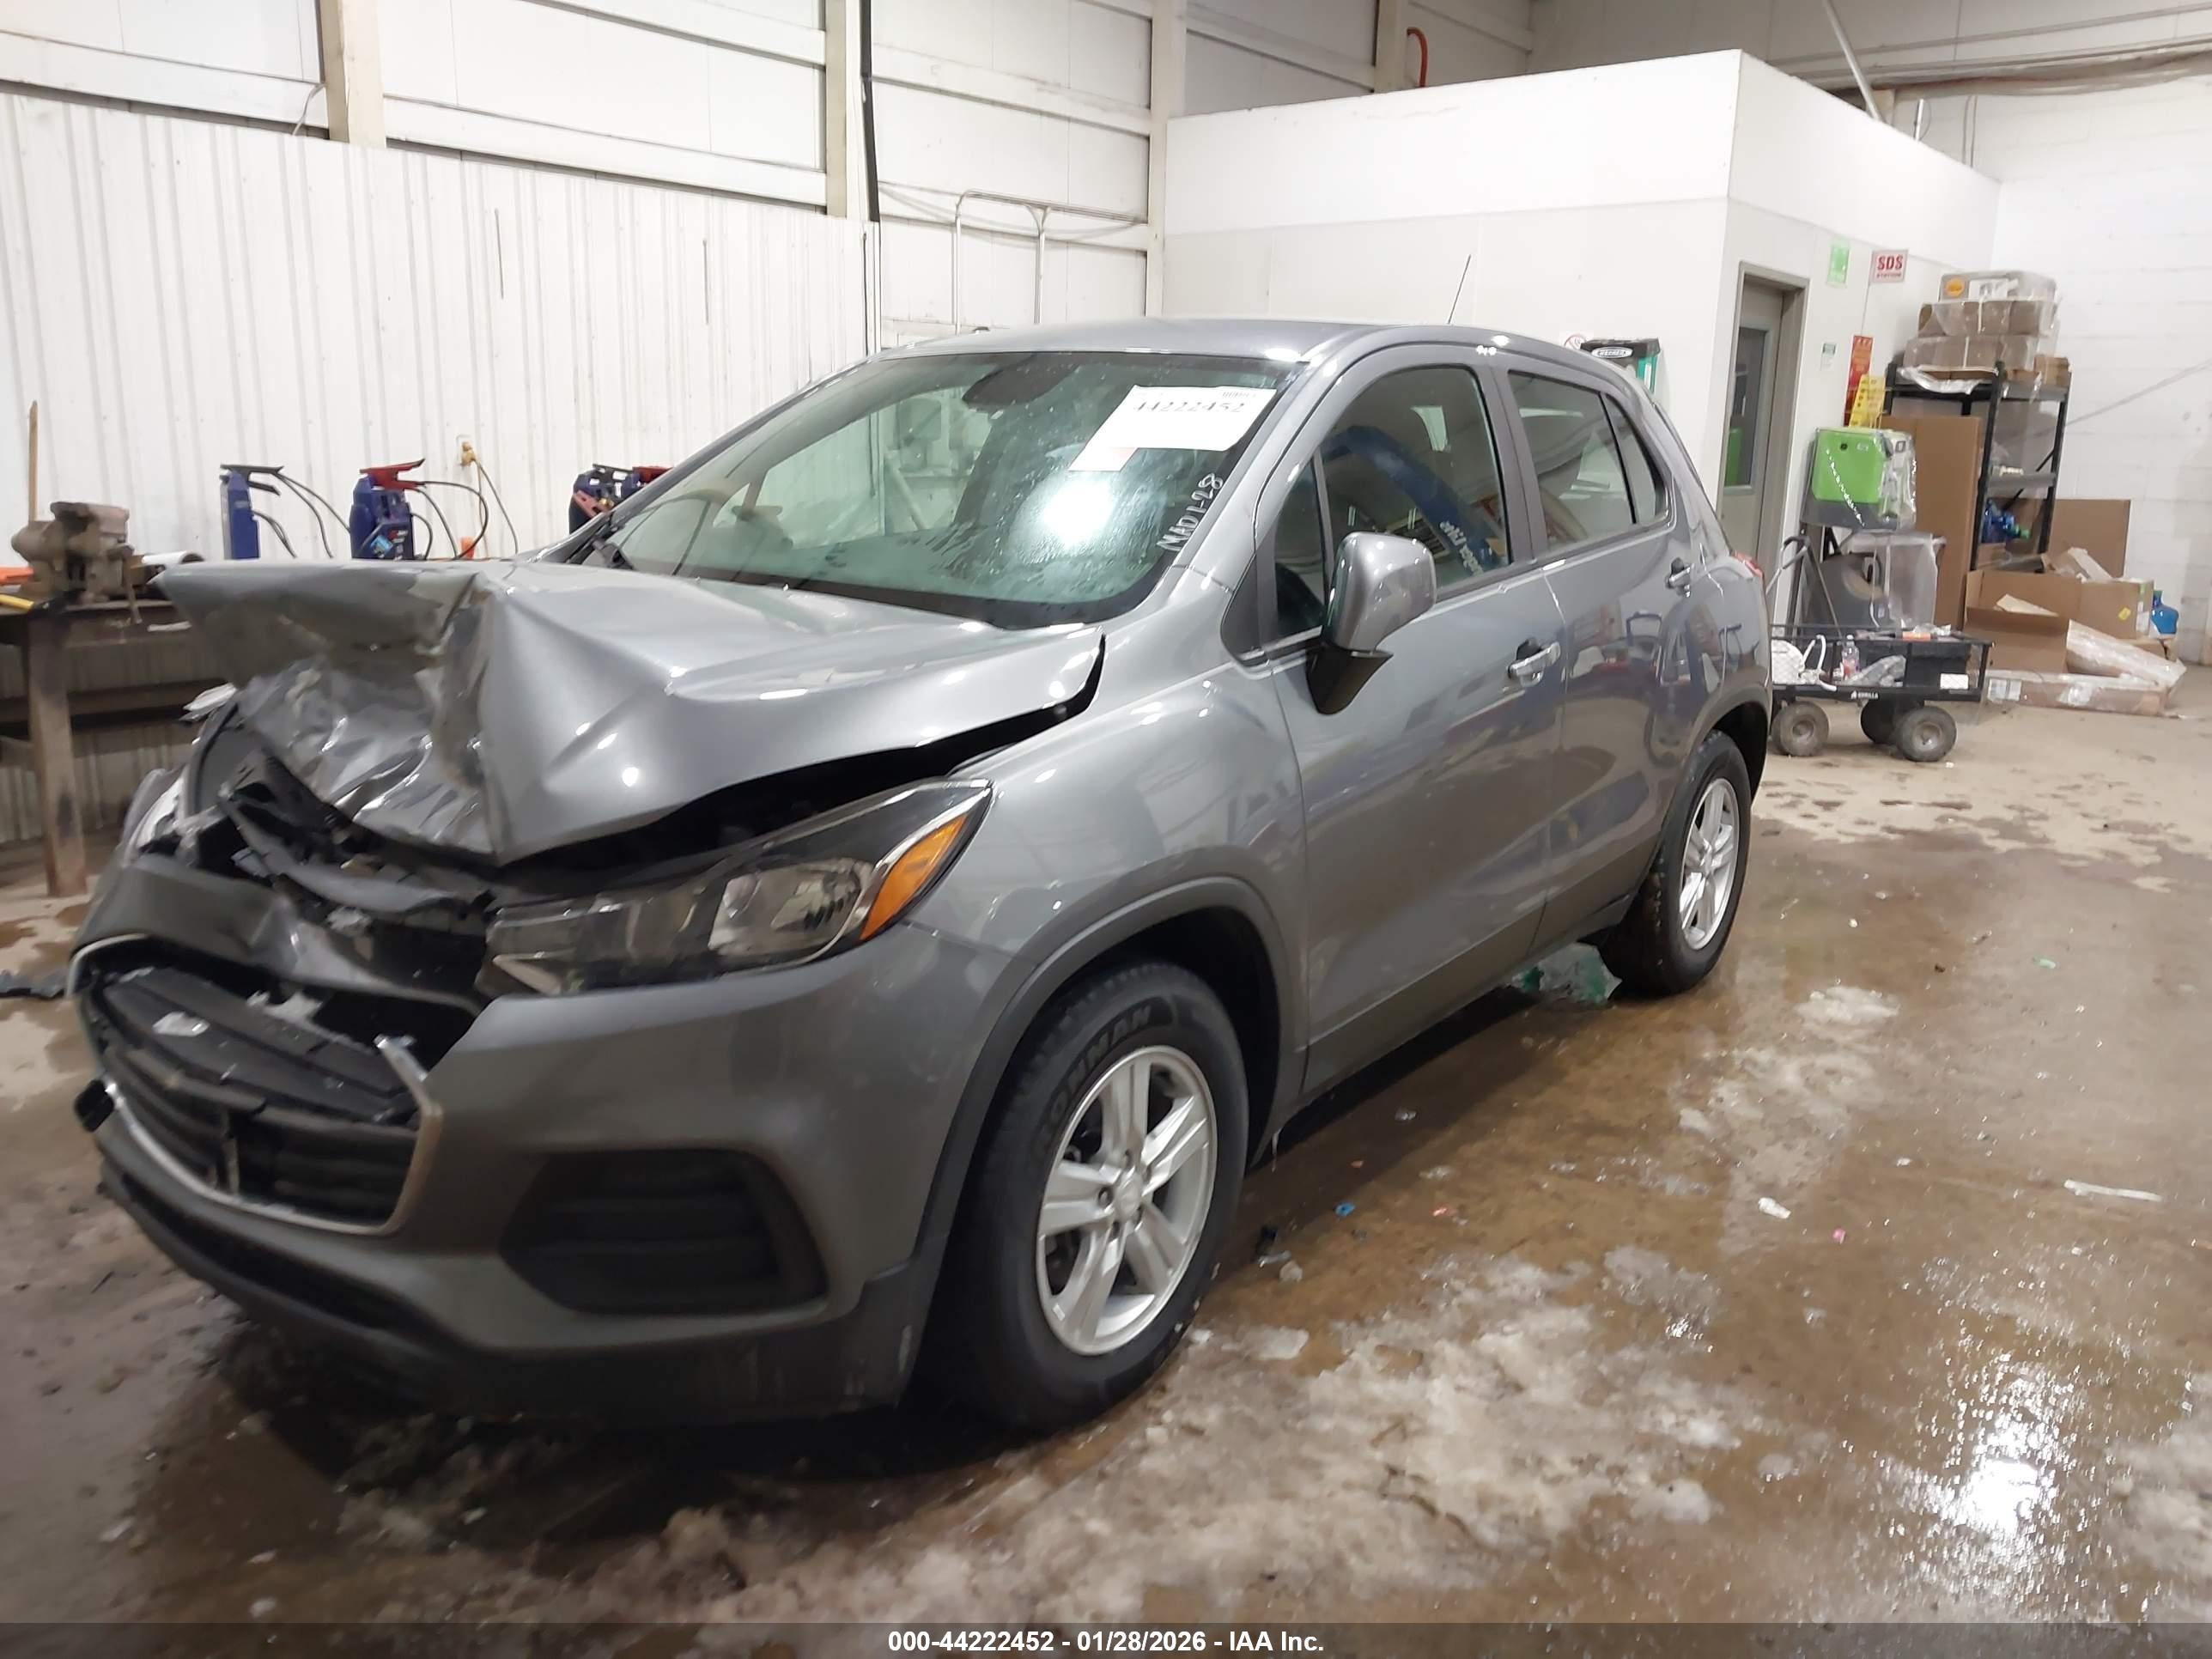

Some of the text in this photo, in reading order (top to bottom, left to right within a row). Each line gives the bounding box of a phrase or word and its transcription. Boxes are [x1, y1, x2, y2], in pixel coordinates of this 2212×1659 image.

[1877, 254, 1904, 270] SDS
[1133, 401, 1246, 413] 44222452
[1156, 515, 1200, 551] MAD
